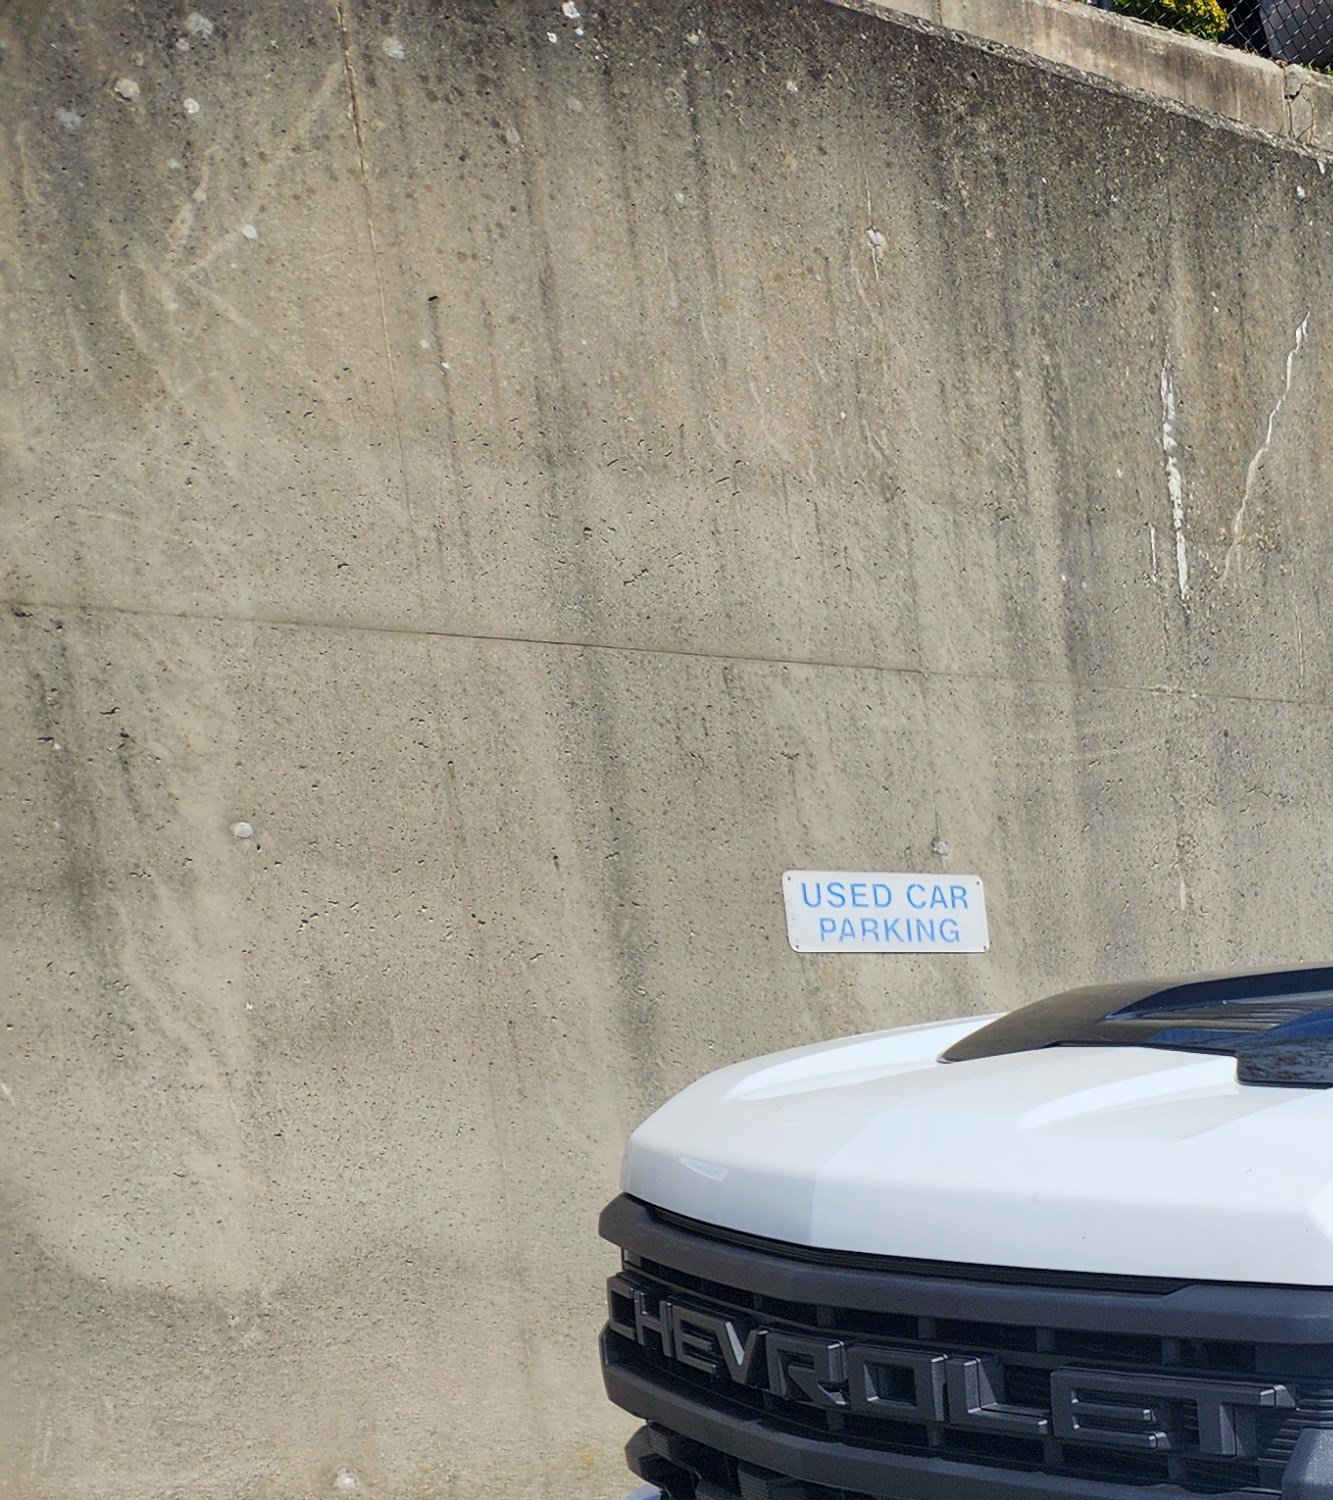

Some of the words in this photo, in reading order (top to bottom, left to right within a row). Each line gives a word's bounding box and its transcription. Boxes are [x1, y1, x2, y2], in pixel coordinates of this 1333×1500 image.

[801, 882, 893, 909] USED
[906, 883, 969, 910] CAR
[819, 917, 961, 943] PARKING
[606, 1275, 1296, 1456] CHEVROLET
